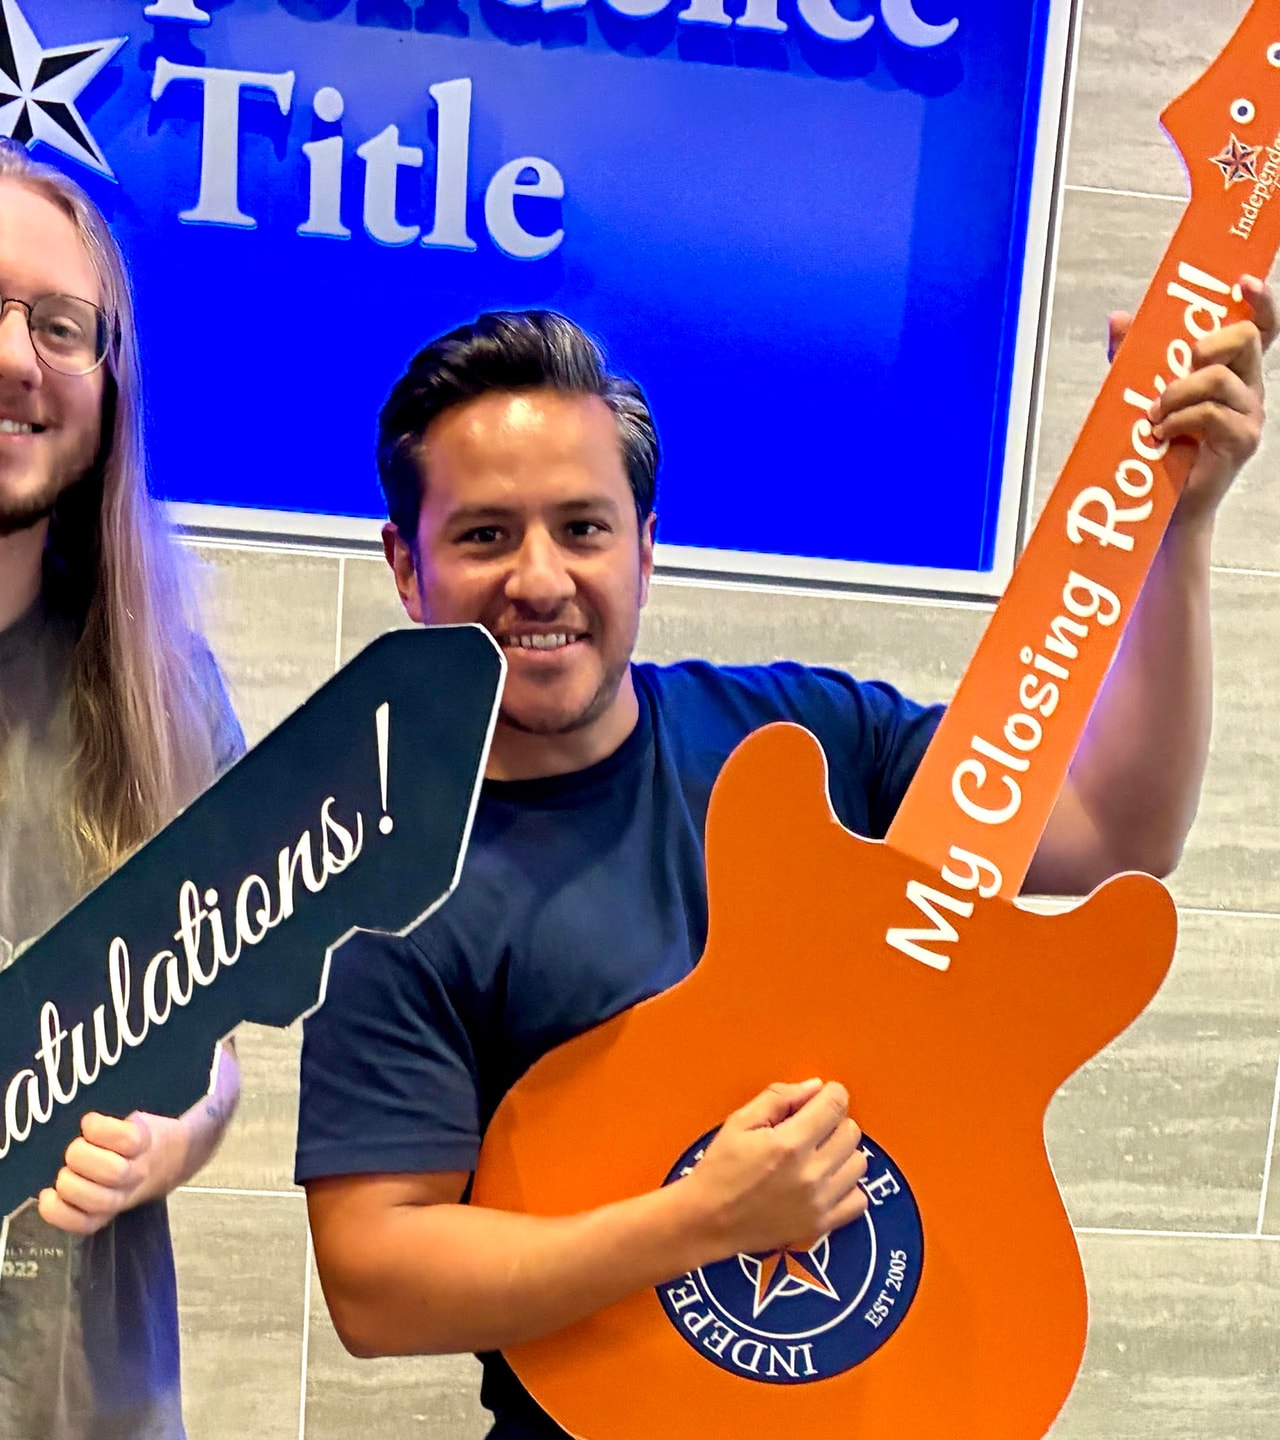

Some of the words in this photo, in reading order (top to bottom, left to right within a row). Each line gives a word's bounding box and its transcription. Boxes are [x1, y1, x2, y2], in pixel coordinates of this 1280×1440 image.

[152, 56, 567, 257] Title
[886, 845, 1003, 972] My
[951, 572, 1120, 825] Closing
[2, 1260, 39, 1278] 022
[864, 1290, 891, 1329] EST
[885, 1249, 908, 1292] 2005
